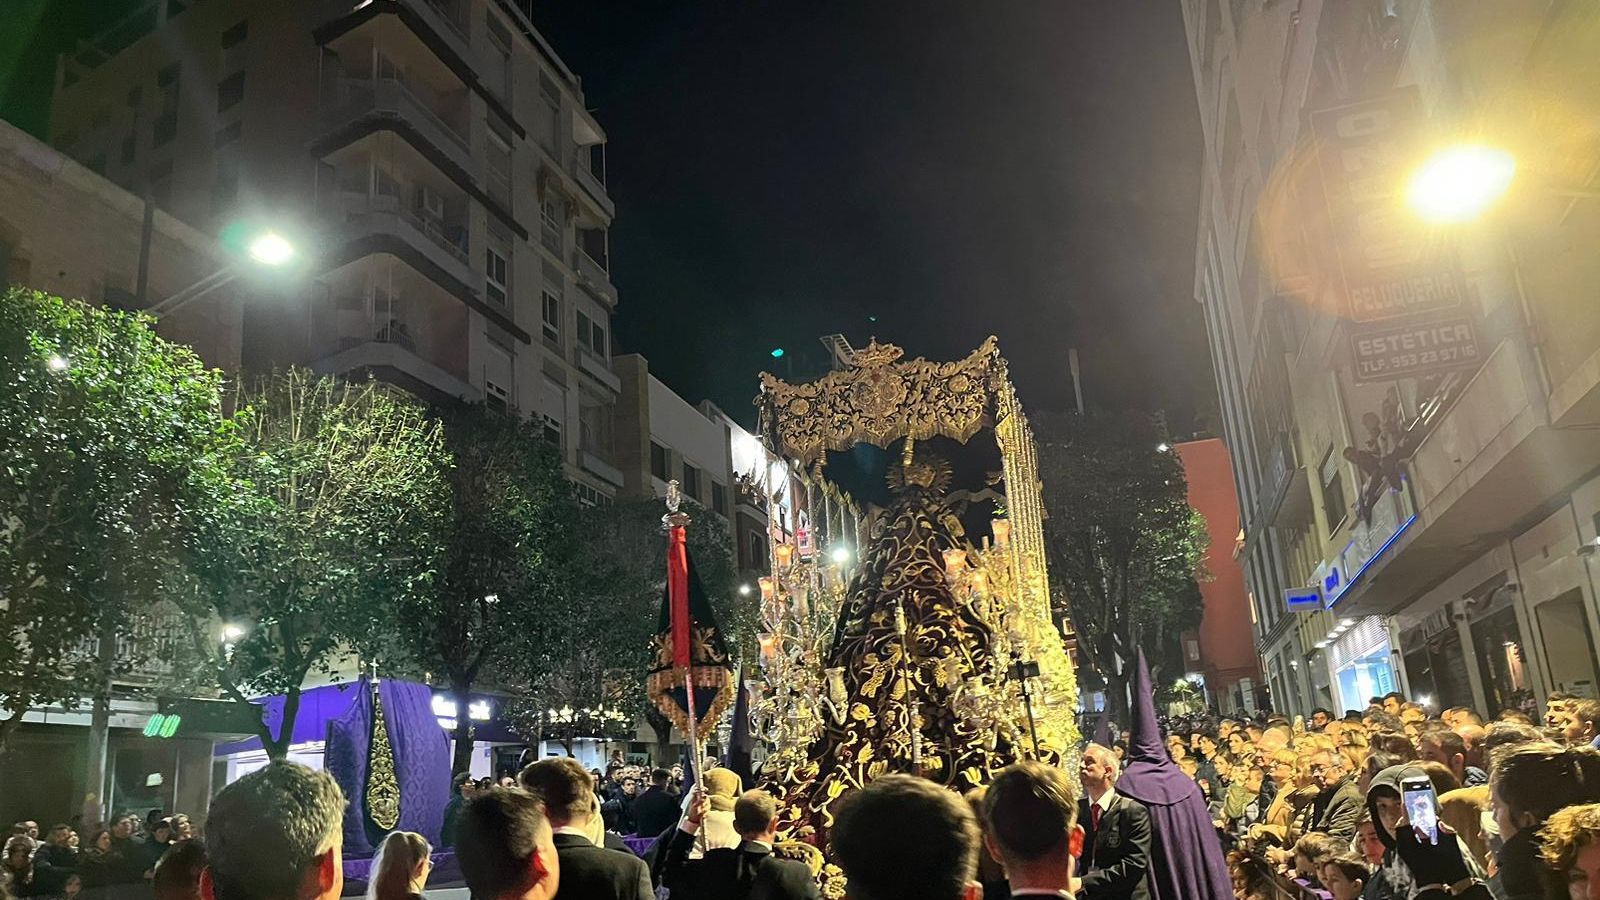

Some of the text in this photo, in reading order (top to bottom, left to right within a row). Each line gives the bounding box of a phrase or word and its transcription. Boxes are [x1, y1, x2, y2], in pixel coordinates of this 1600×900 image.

[1358, 324, 1471, 356] ESTÉTICA
[1361, 359, 1390, 372] TLF.
[1392, 354, 1417, 368] 953
[1420, 351, 1438, 364] 23
